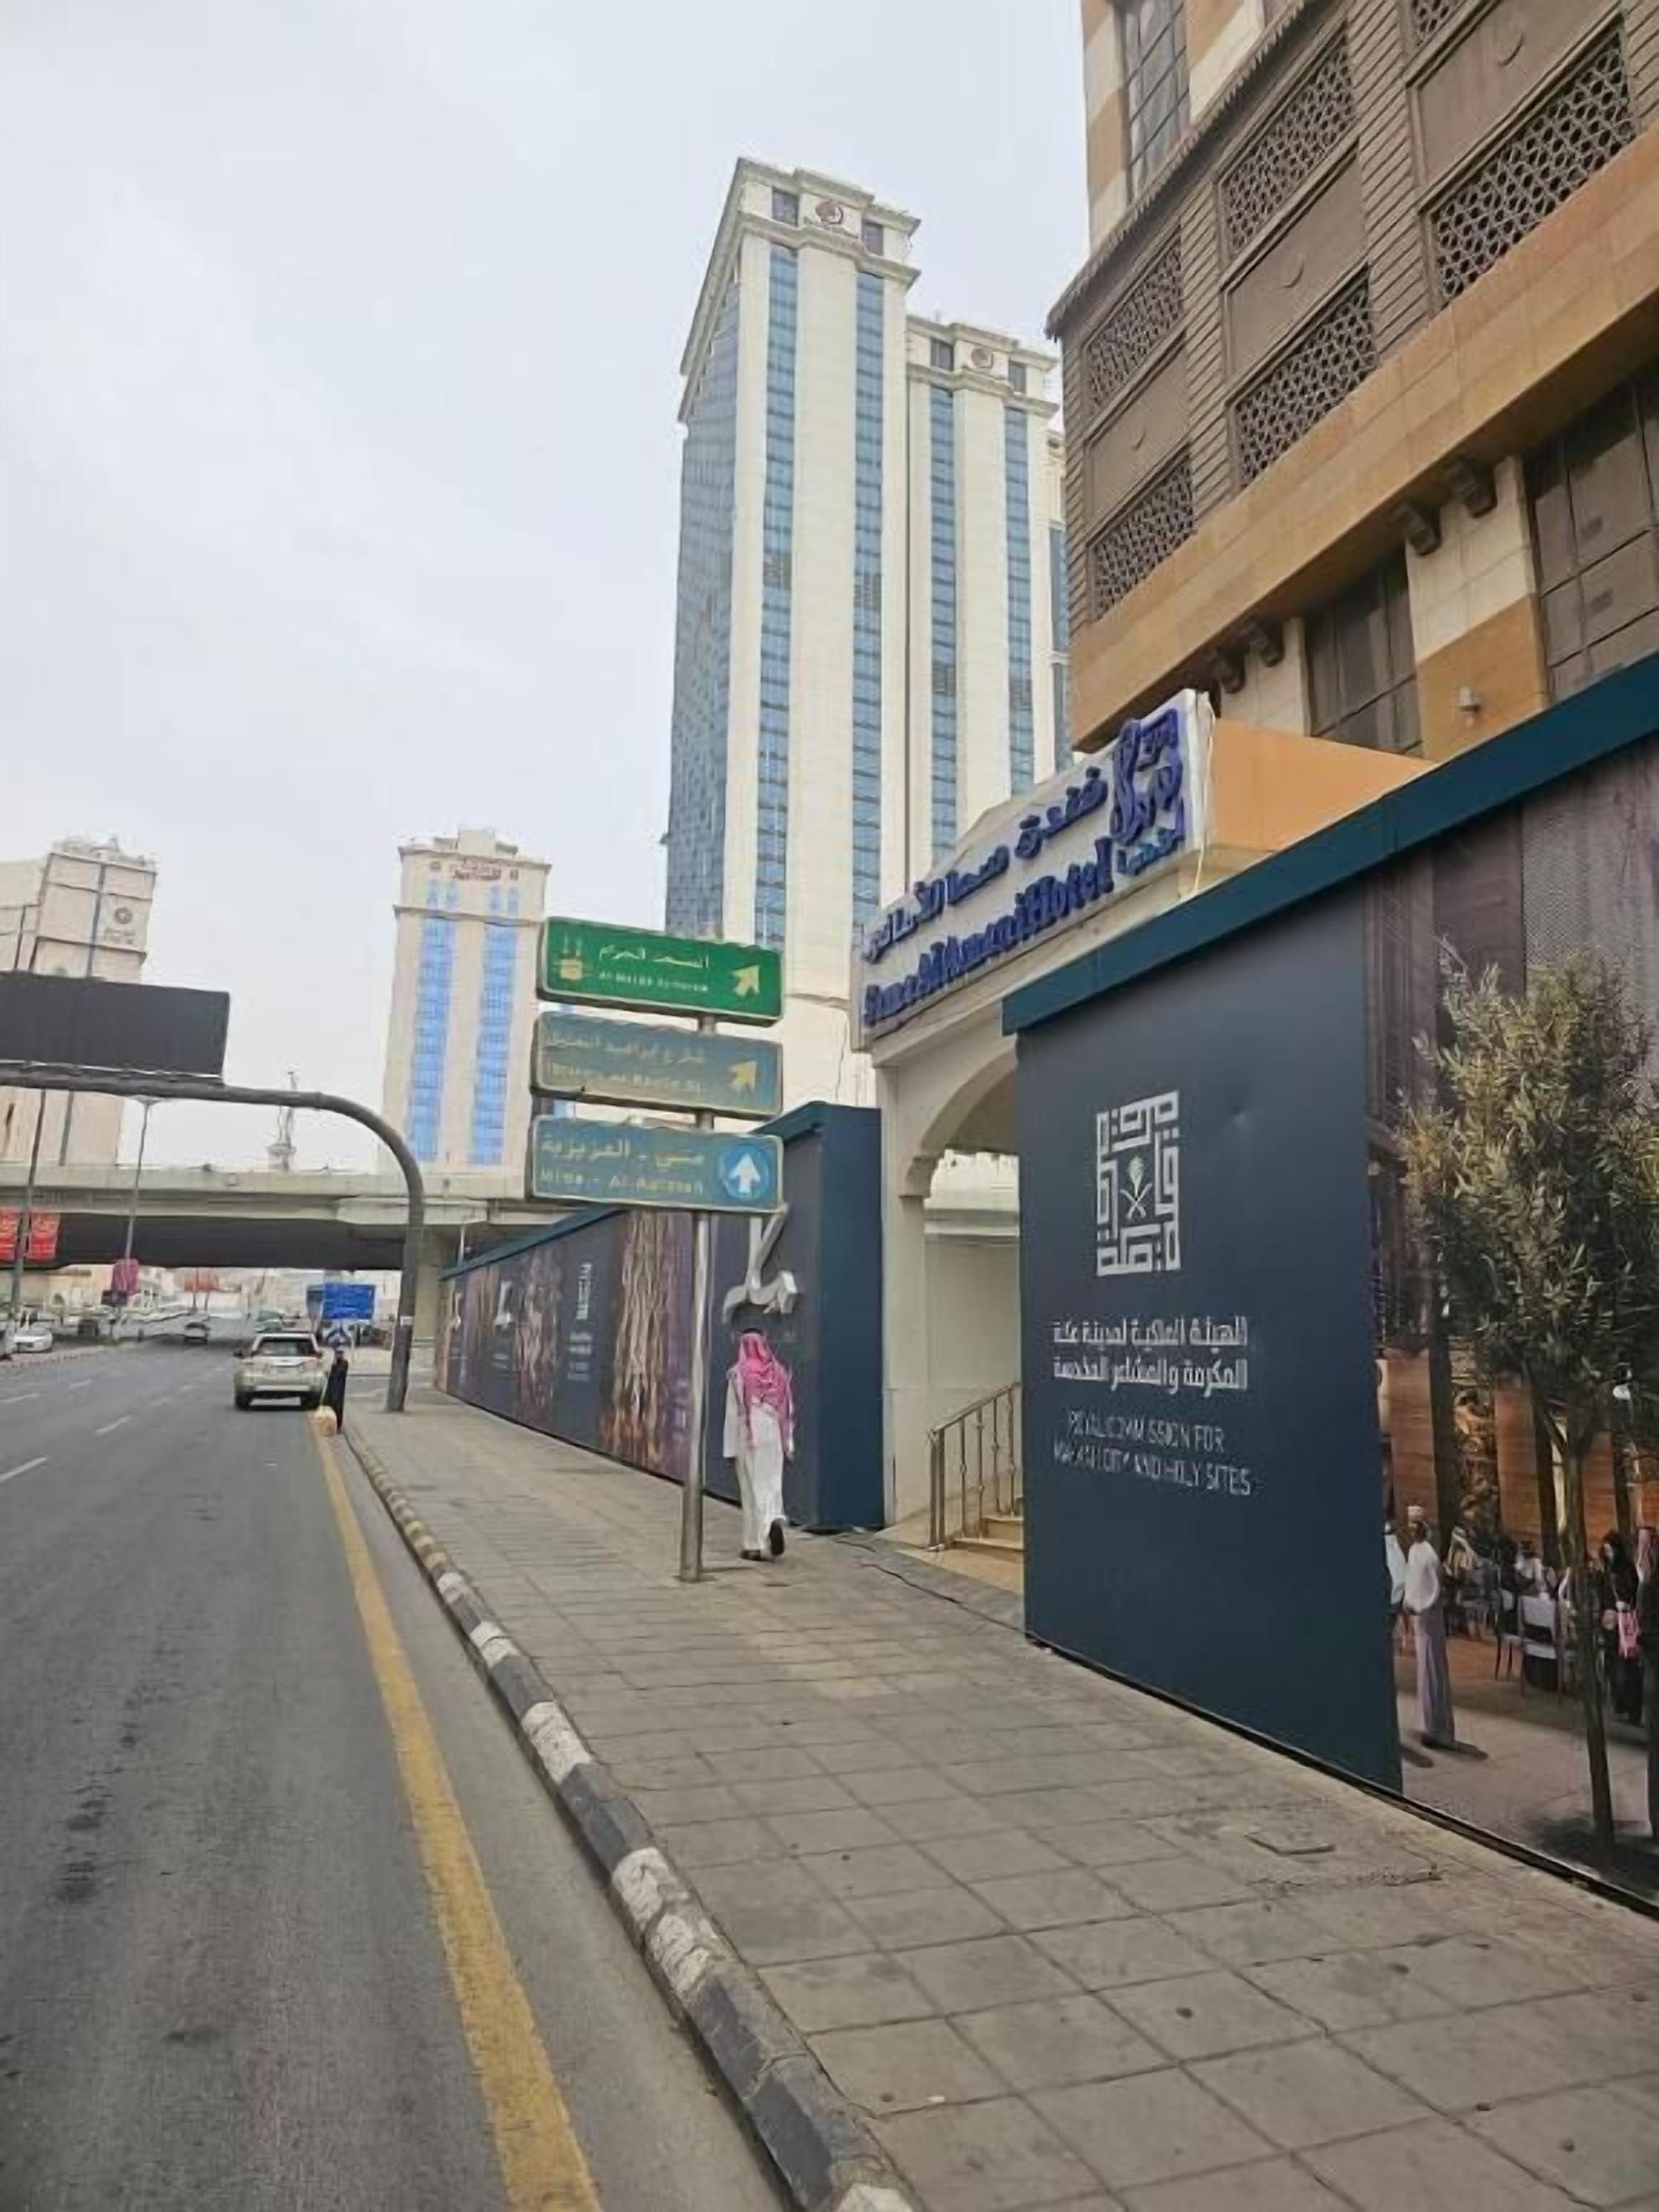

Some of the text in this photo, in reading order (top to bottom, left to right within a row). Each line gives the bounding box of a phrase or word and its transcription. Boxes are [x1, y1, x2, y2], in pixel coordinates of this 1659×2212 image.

[1015, 766, 1108, 860] فندق
[1023, 837, 1115, 936] Hotel
[1183, 1357, 1248, 1398] المكرمة
[1194, 1424, 1226, 1453] FOR
[1206, 1462, 1251, 1496] SITES
